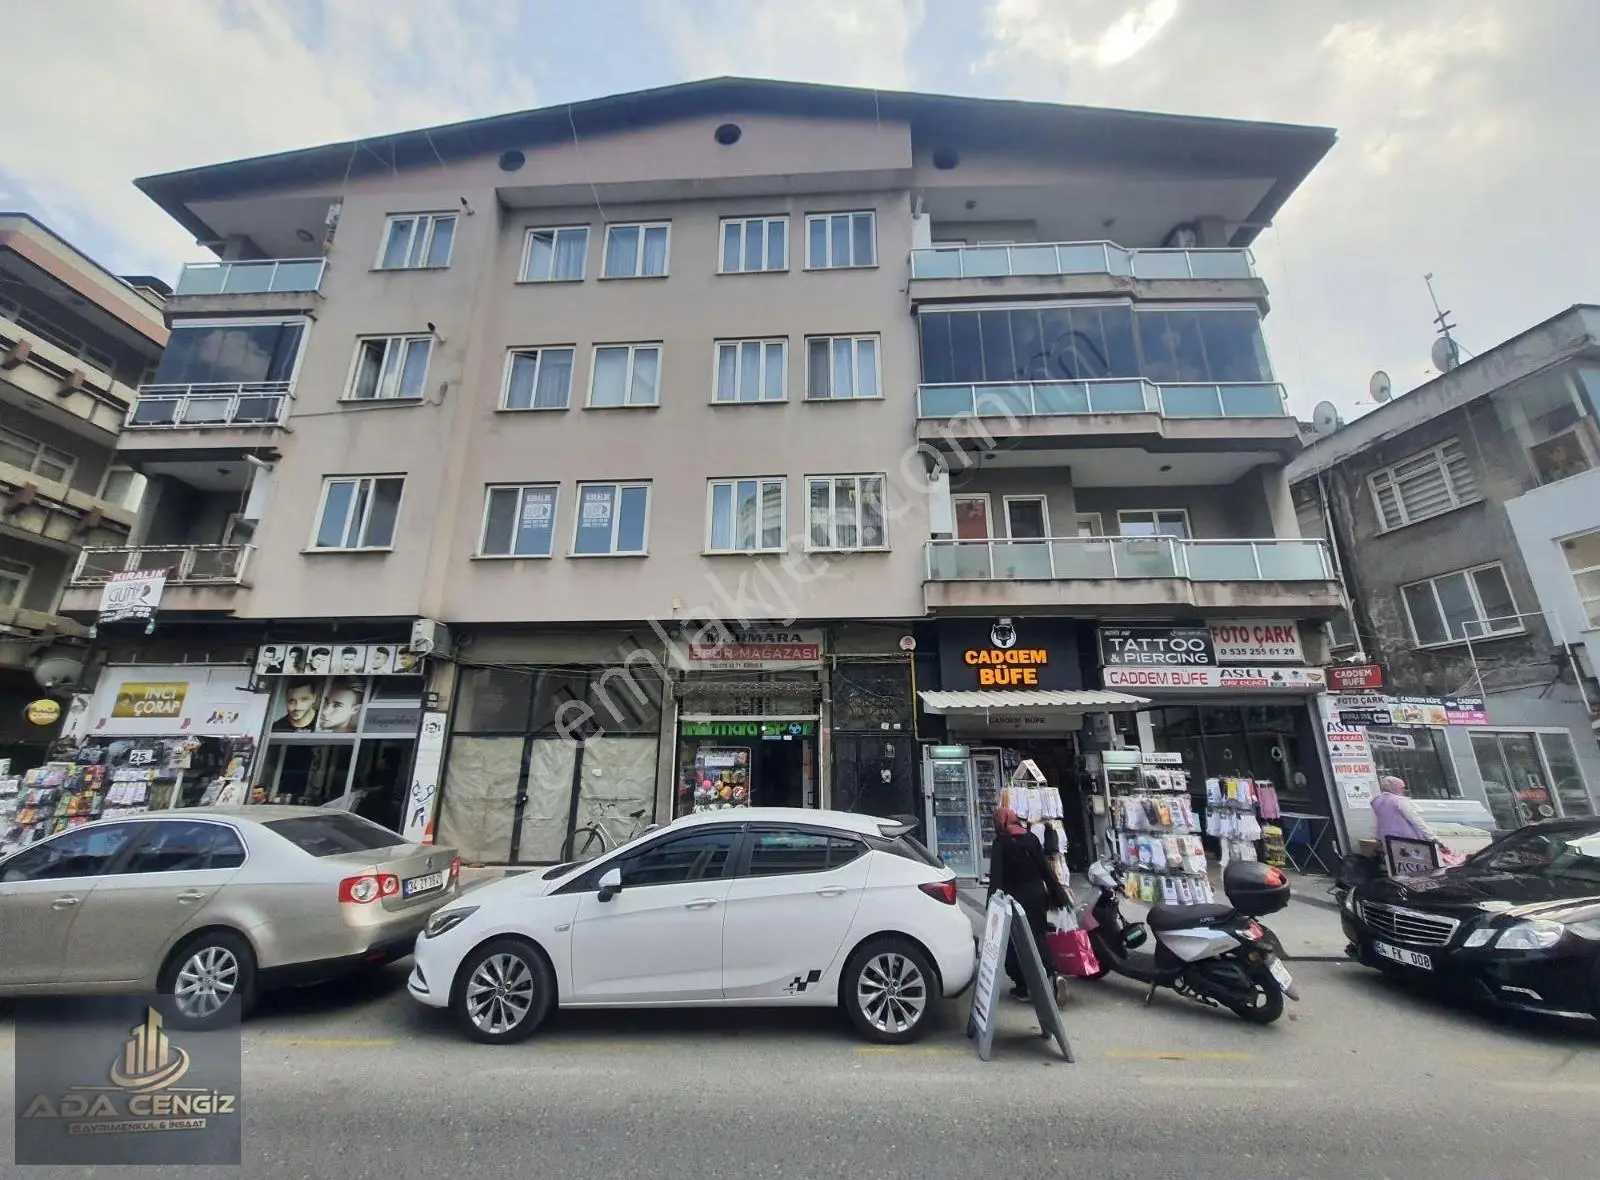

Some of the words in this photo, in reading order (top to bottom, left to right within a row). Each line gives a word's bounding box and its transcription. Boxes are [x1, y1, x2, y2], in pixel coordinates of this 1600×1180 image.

[706, 631, 803, 643] MRMARA
[1211, 627, 1250, 643] FOTO
[1254, 626, 1296, 647] ÇARK
[1110, 638, 1205, 651] TATTOO
[965, 650, 1048, 665] CADDEM
[1110, 654, 1121, 663] &
[1124, 653, 1209, 664] PIERCING
[980, 665, 1038, 685] BÜFE
[1110, 671, 1168, 685] CADDEM
[1172, 669, 1209, 686] BÜFE
[1334, 669, 1373, 679] CADDEM
[134, 701, 180, 716] ÇORAP
